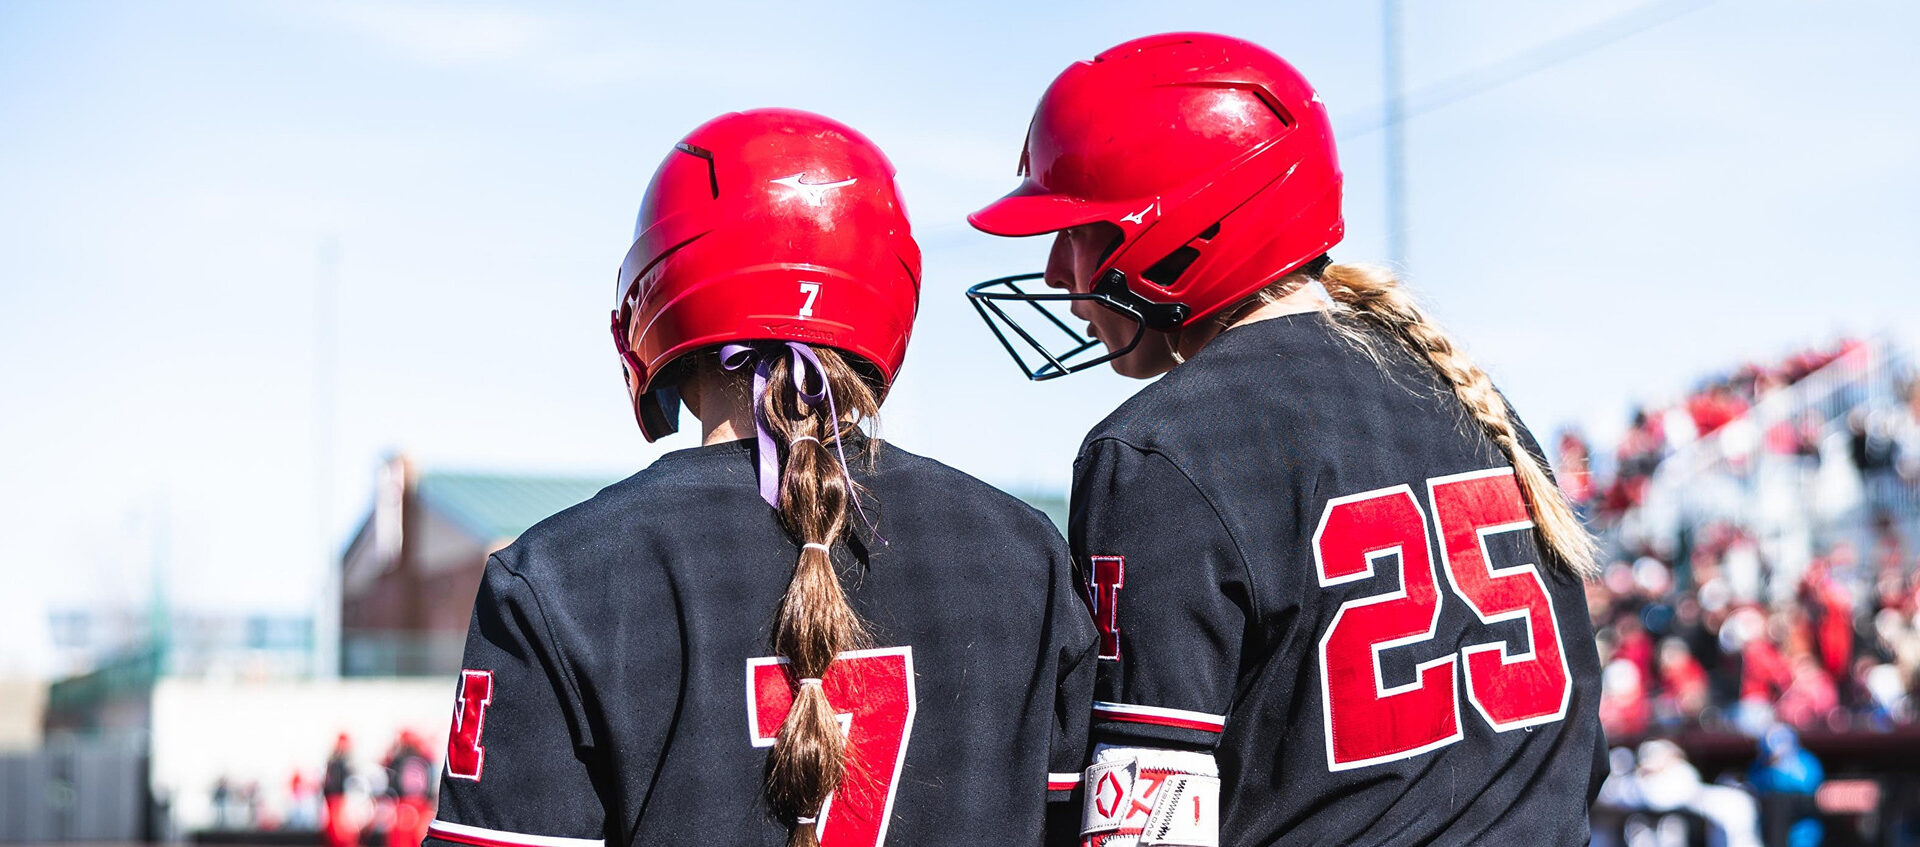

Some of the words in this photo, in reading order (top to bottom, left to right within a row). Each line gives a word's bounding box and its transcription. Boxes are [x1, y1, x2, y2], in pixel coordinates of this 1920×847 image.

[799, 282, 820, 317] 7
[1311, 466, 1573, 772] 25
[746, 645, 917, 847] 7
